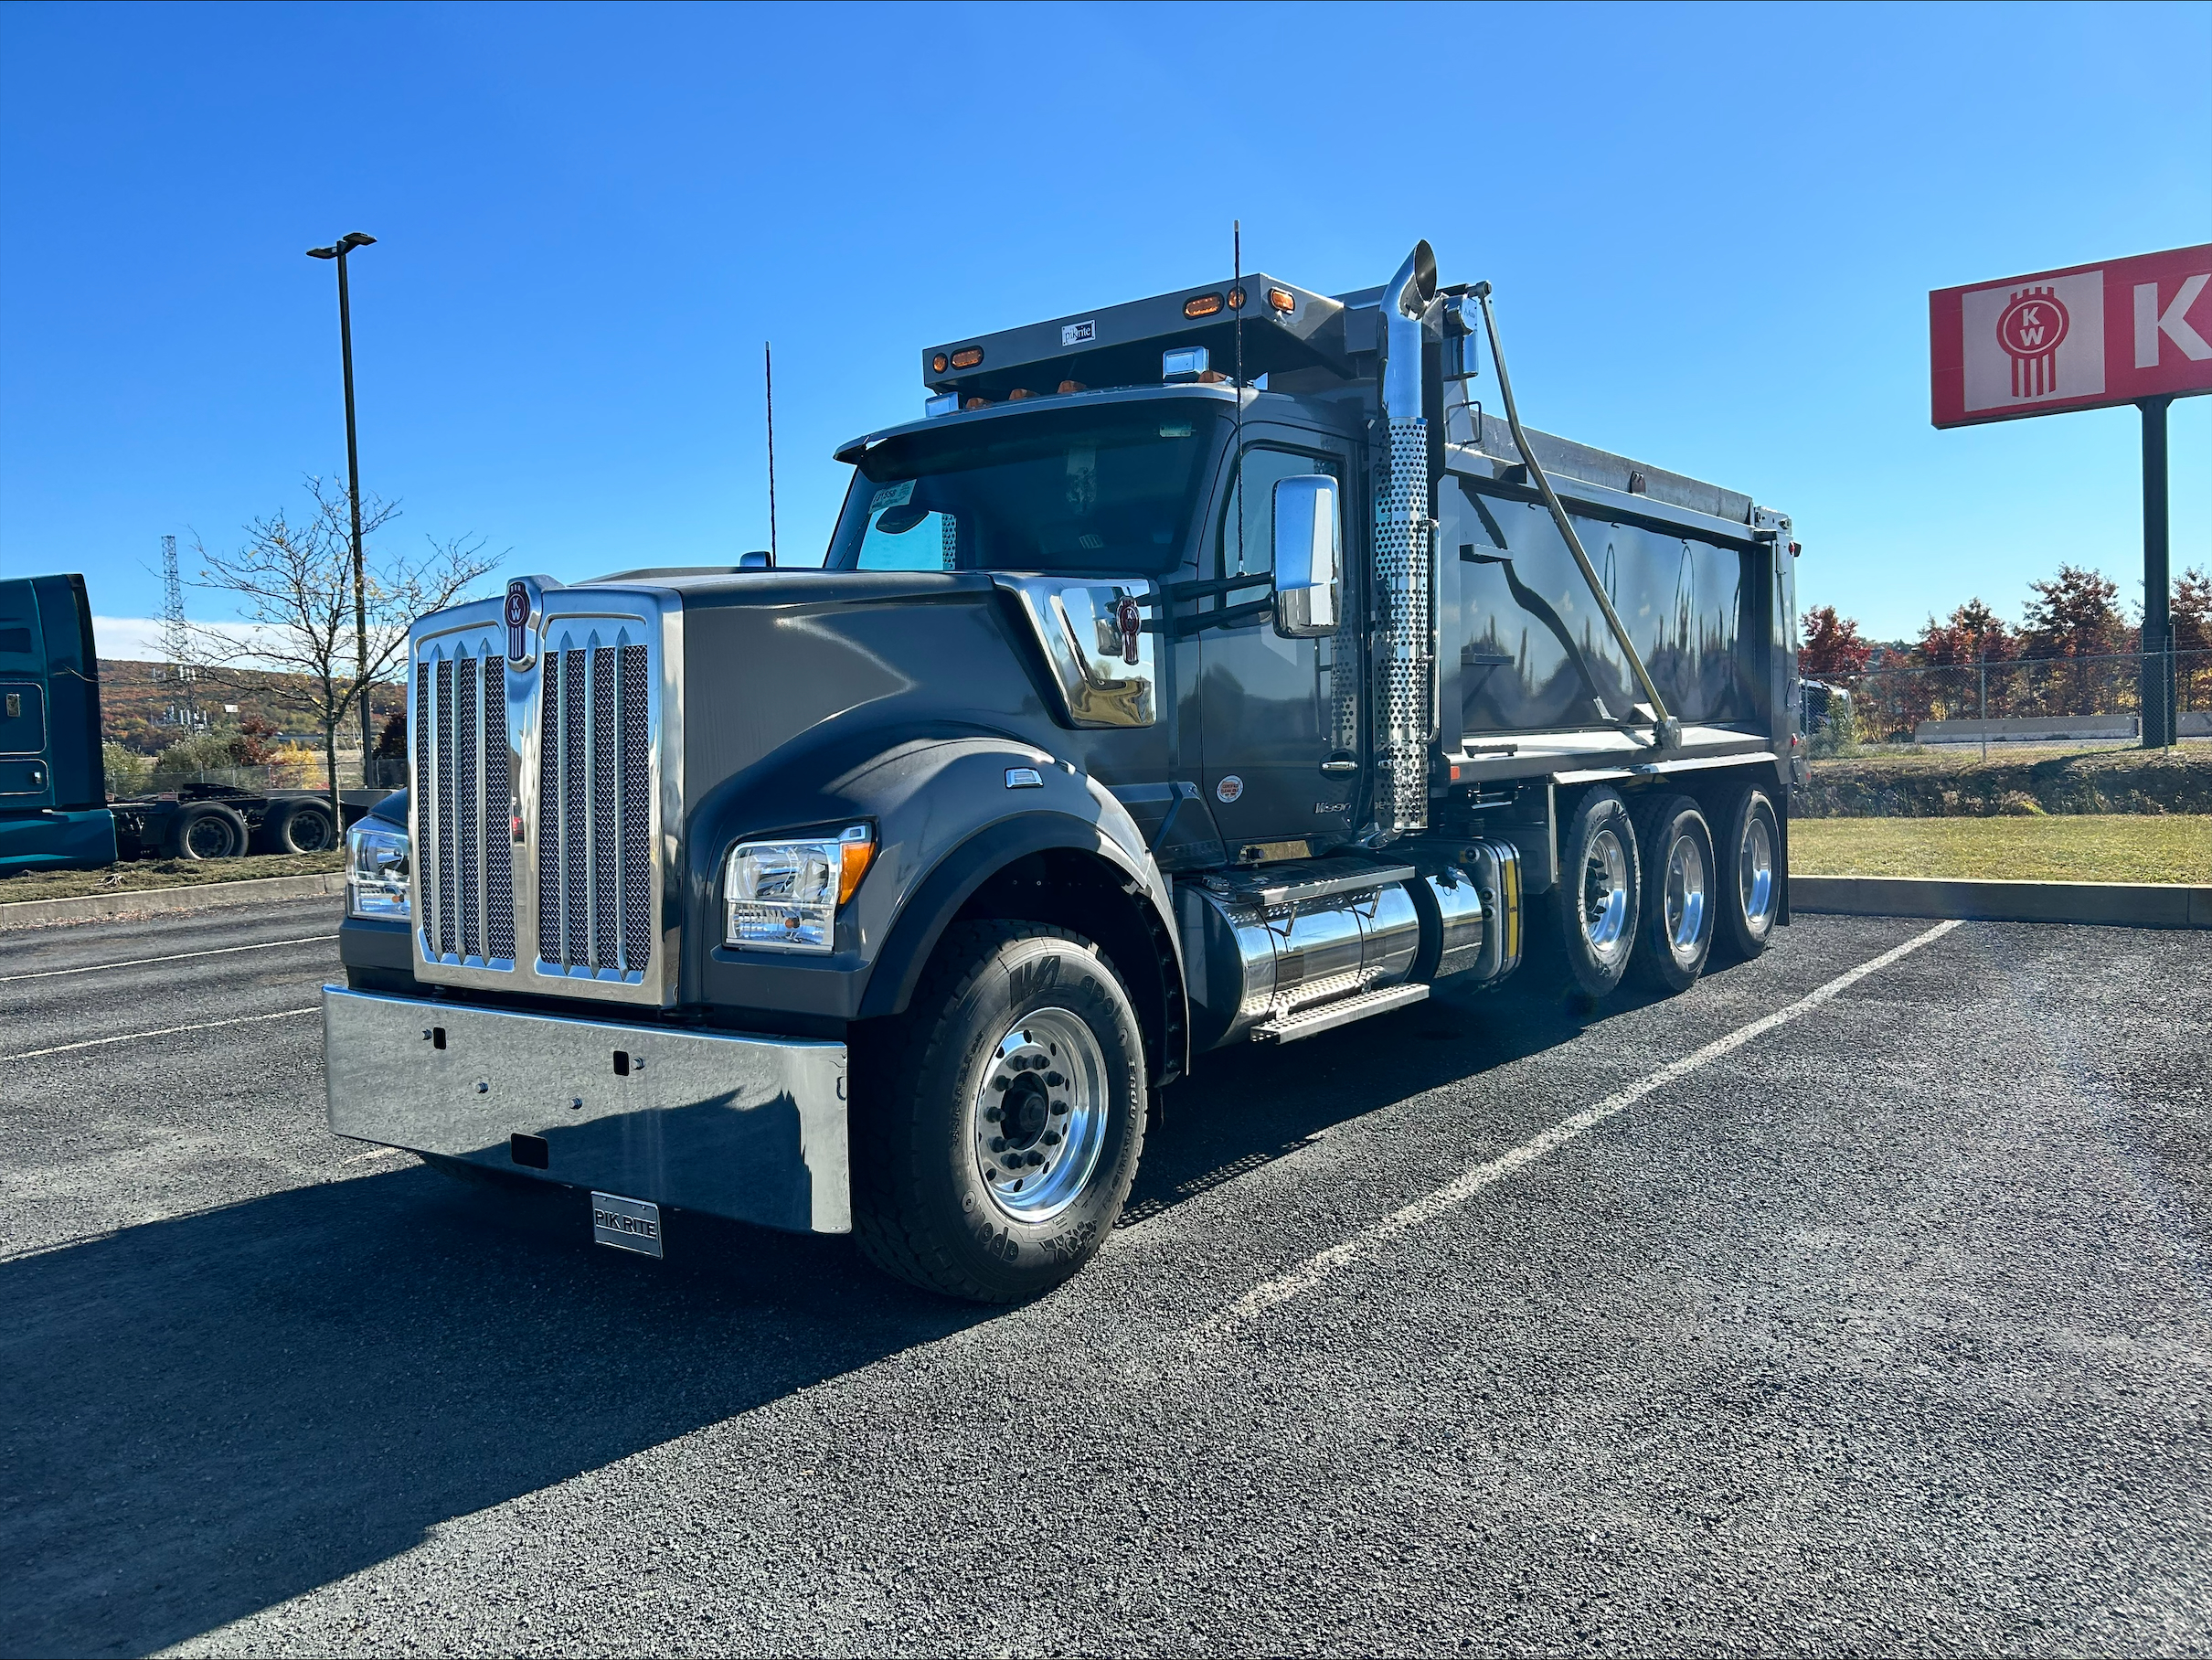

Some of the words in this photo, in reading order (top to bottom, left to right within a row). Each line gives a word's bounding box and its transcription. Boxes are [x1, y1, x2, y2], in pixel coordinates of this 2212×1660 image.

[2133, 274, 2212, 369] K
[594, 1208, 621, 1229] PIK
[622, 1214, 657, 1239] RITE
